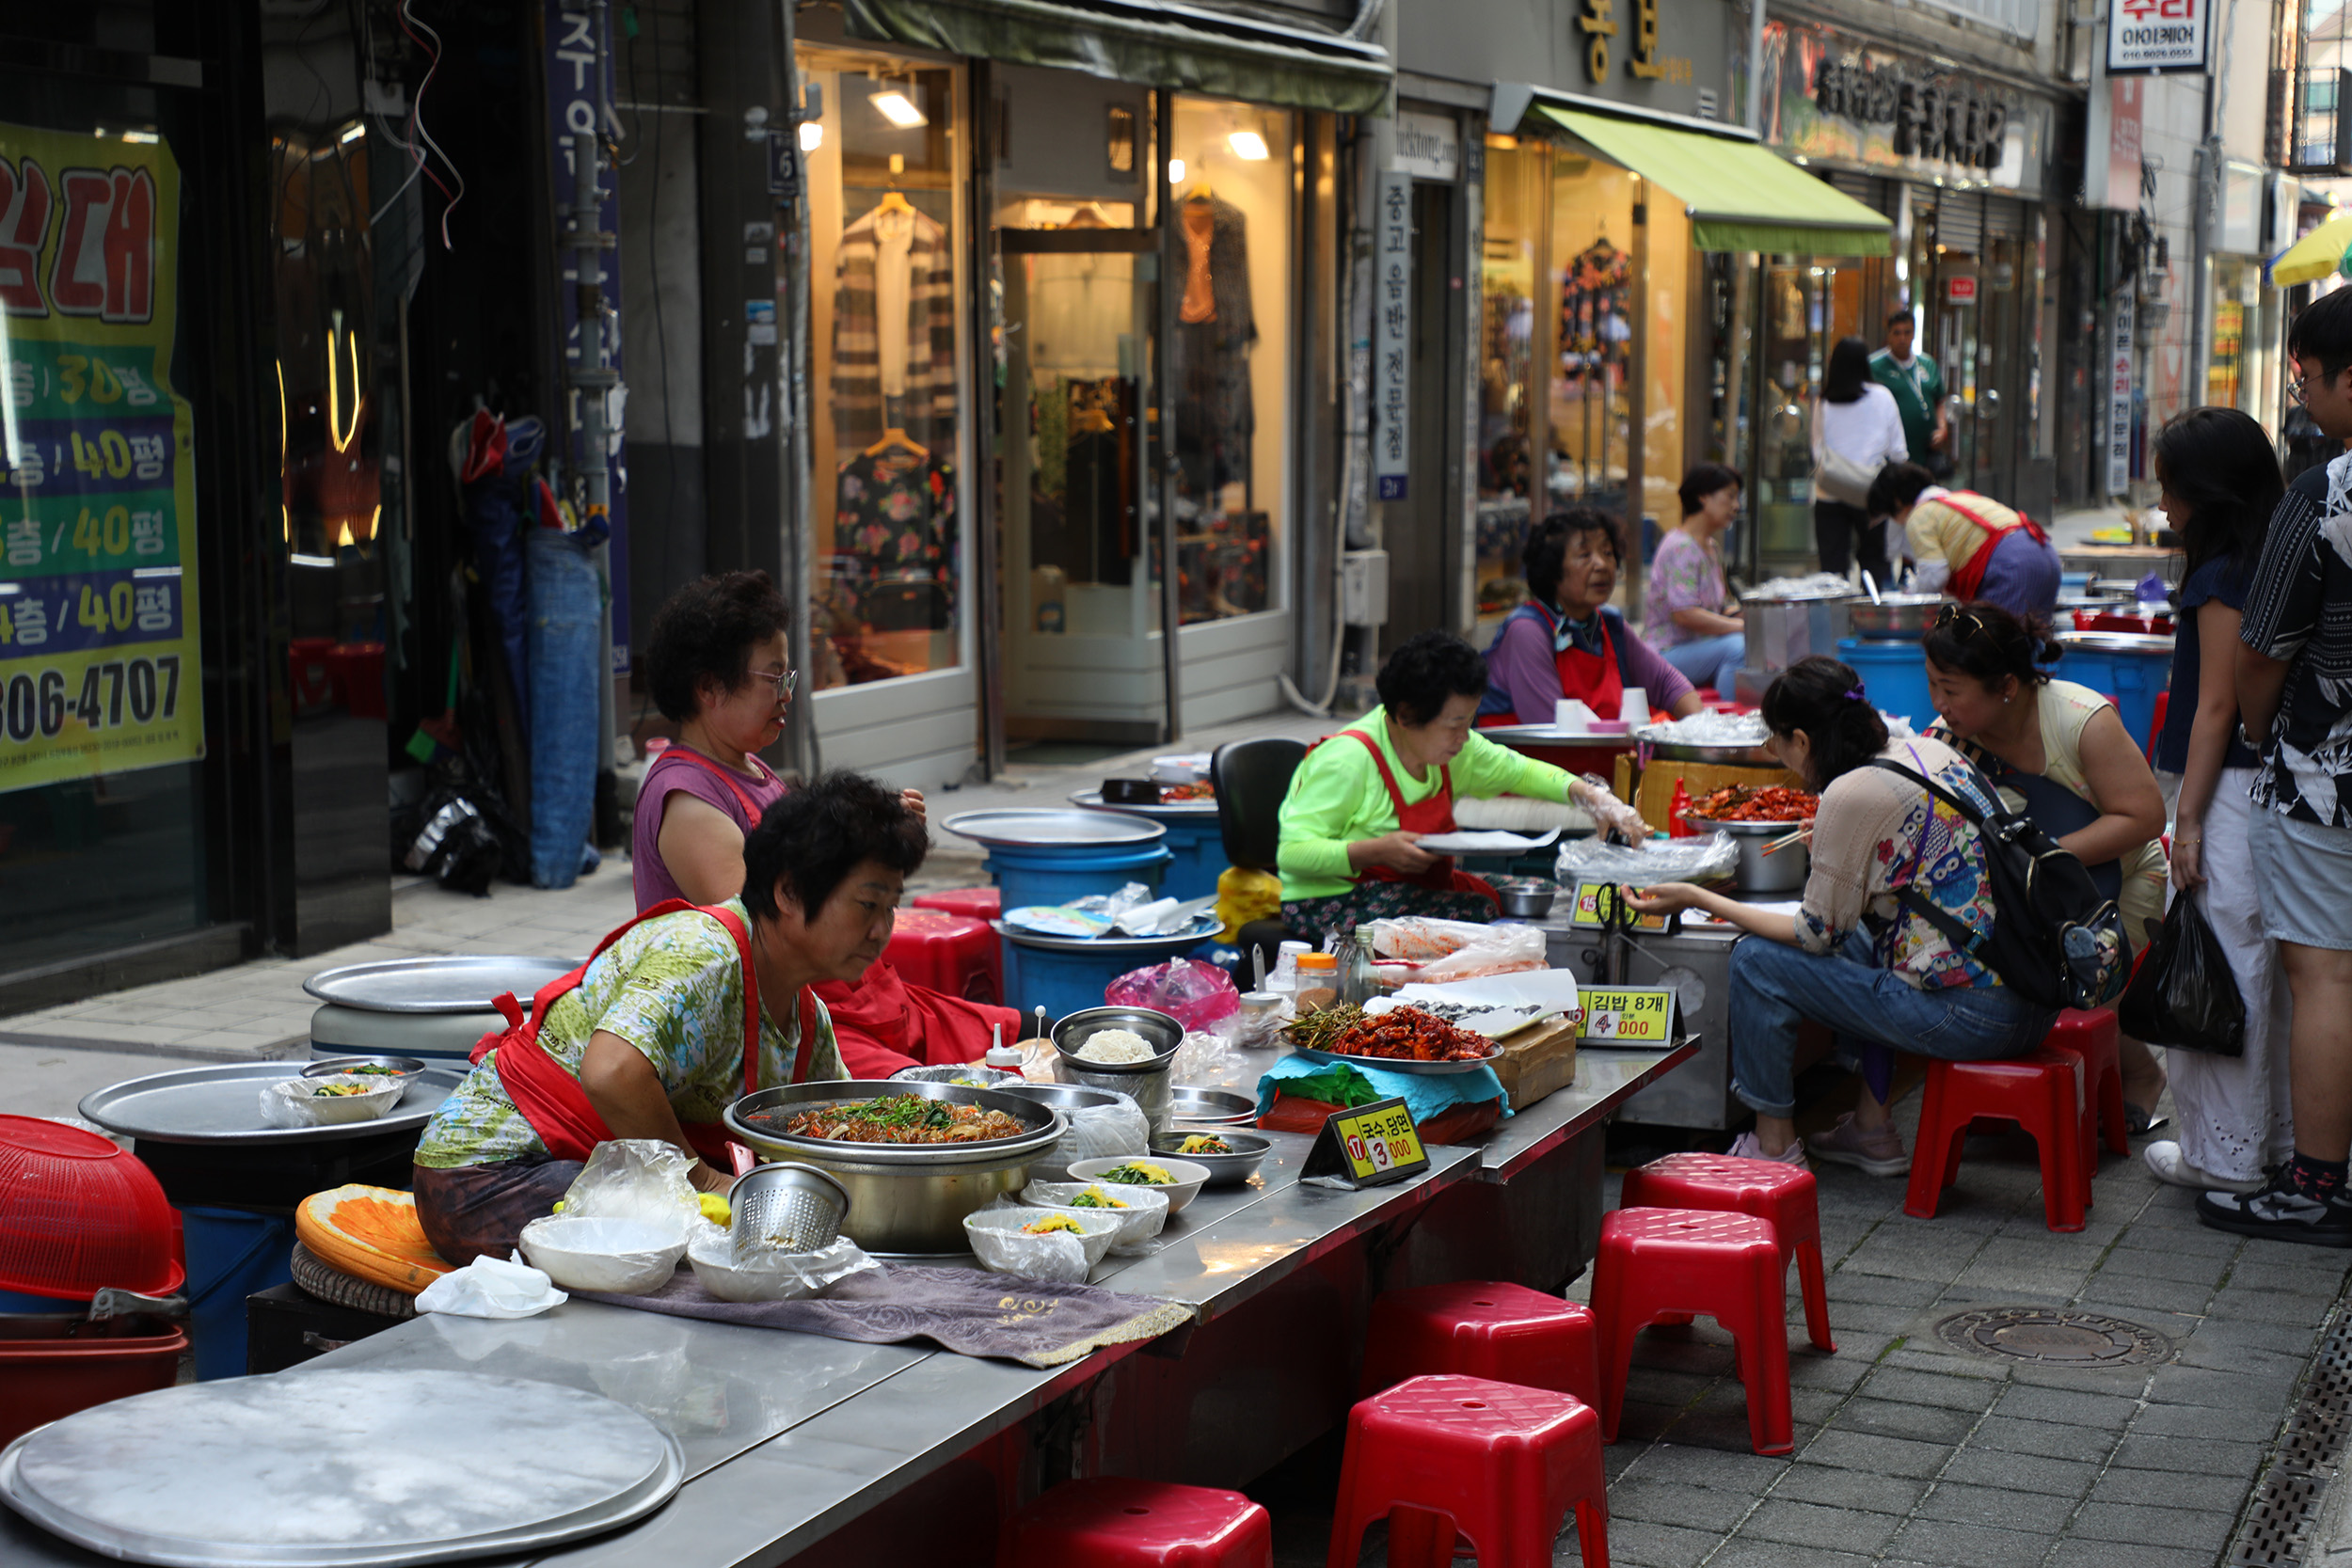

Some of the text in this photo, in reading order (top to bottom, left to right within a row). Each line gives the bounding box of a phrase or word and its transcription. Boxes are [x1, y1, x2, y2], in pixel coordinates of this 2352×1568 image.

[2123, 0, 2195, 22] 수리
[0, 654, 181, 744] 06-4707
[1581, 895, 1597, 911] 15
[1595, 995, 1663, 1012] 김밥 8개
[1595, 1014, 1648, 1035] 4 000
[1348, 1137, 1363, 1160] 17
[1374, 1138, 1411, 1166] 3 000
